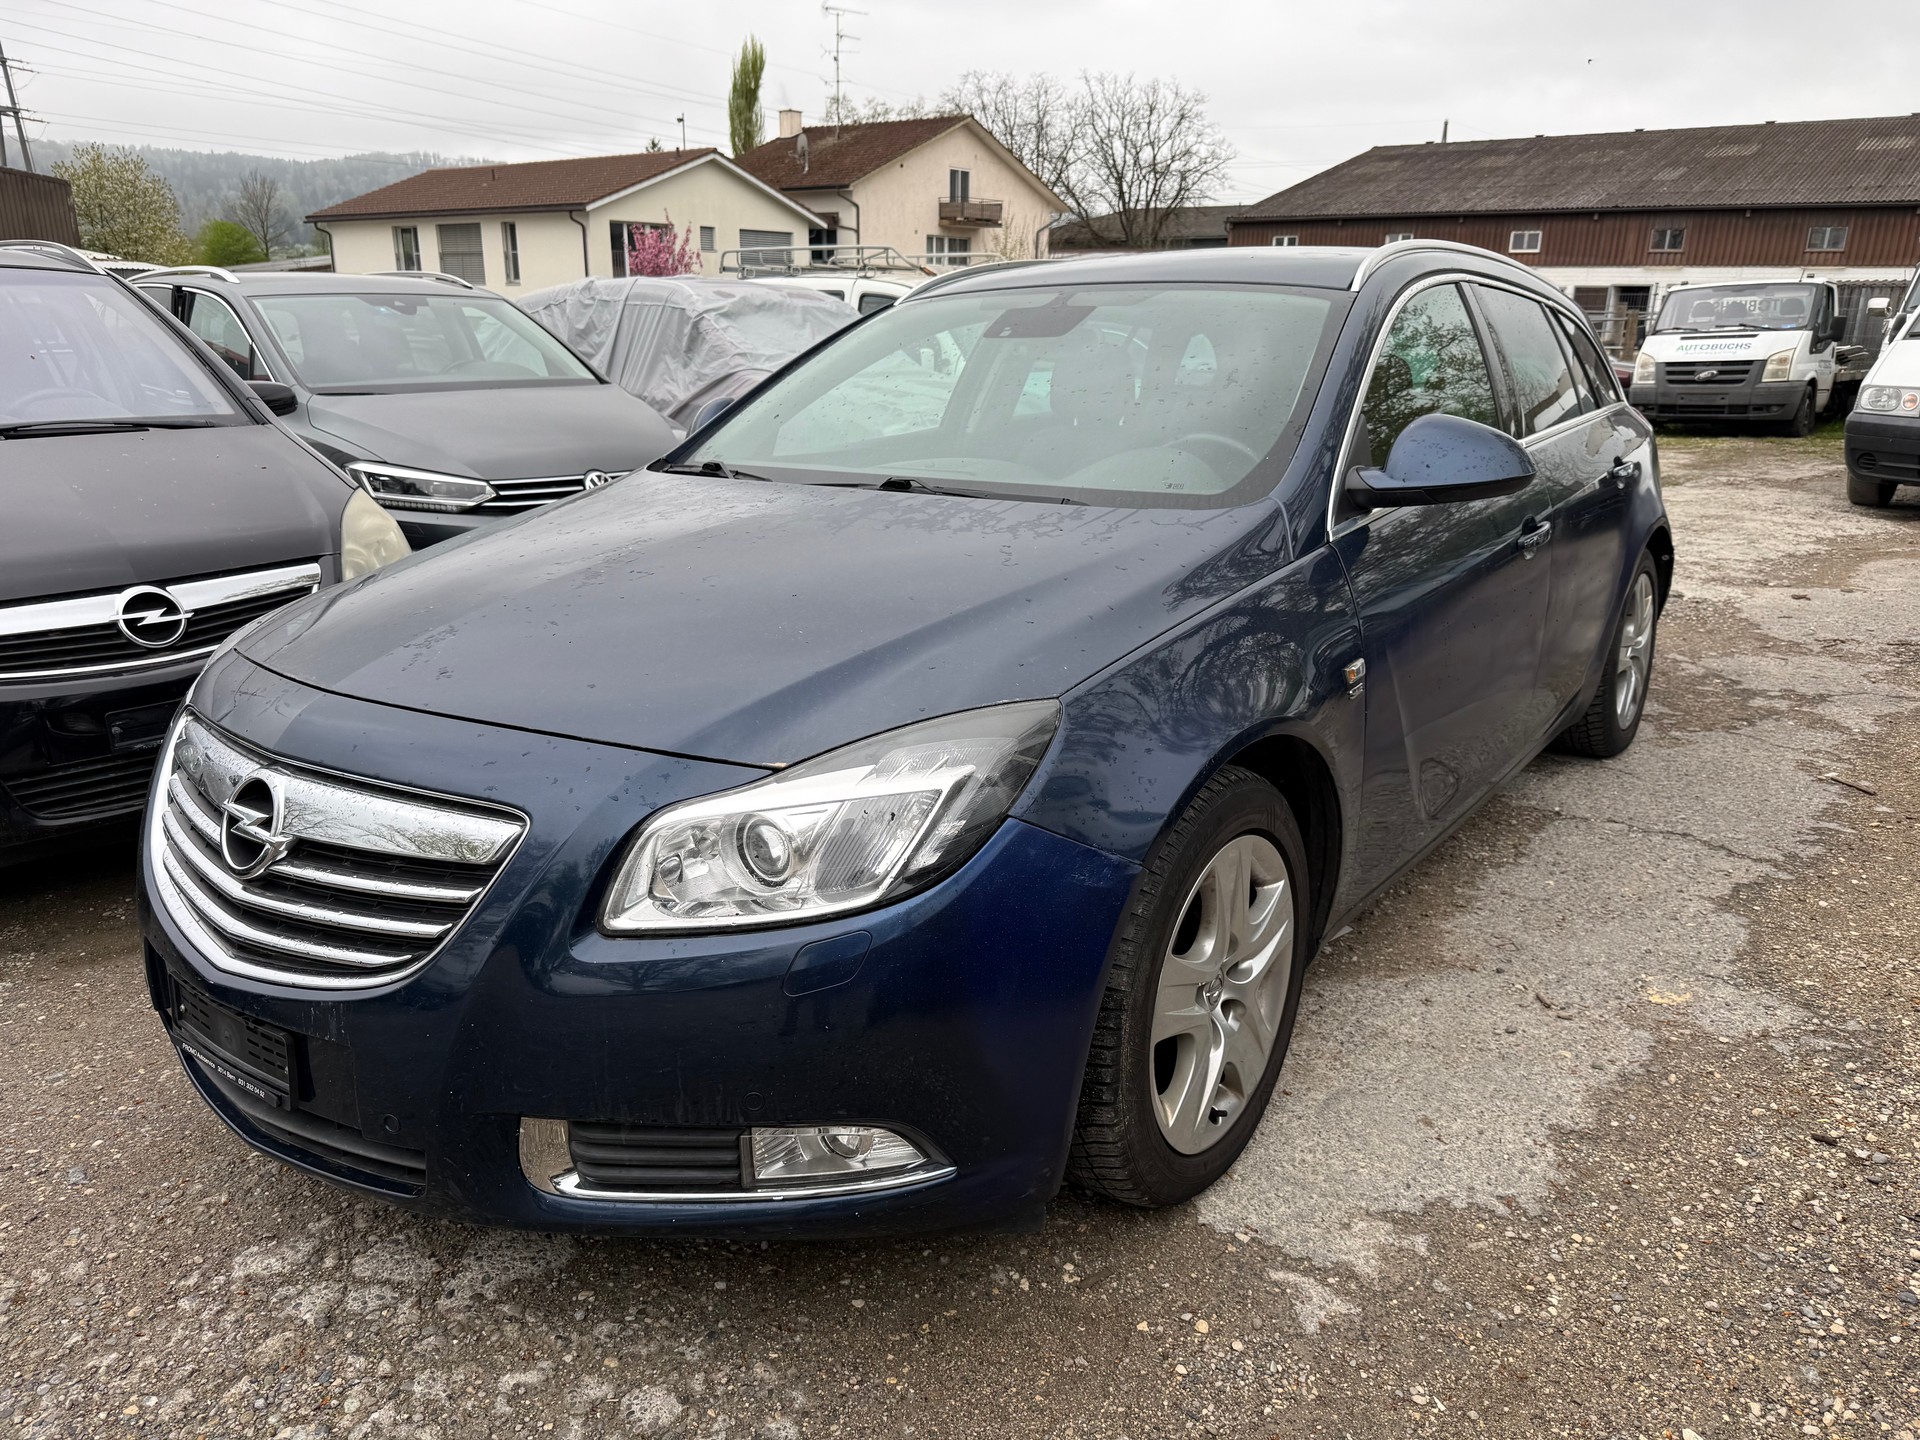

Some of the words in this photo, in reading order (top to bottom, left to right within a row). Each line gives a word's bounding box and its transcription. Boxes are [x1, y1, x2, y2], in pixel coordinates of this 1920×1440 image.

[1676, 342, 1752, 352] AUTOBUCHS
[182, 1042, 197, 1056] PROMO
[227, 1071, 236, 1081] Bern
